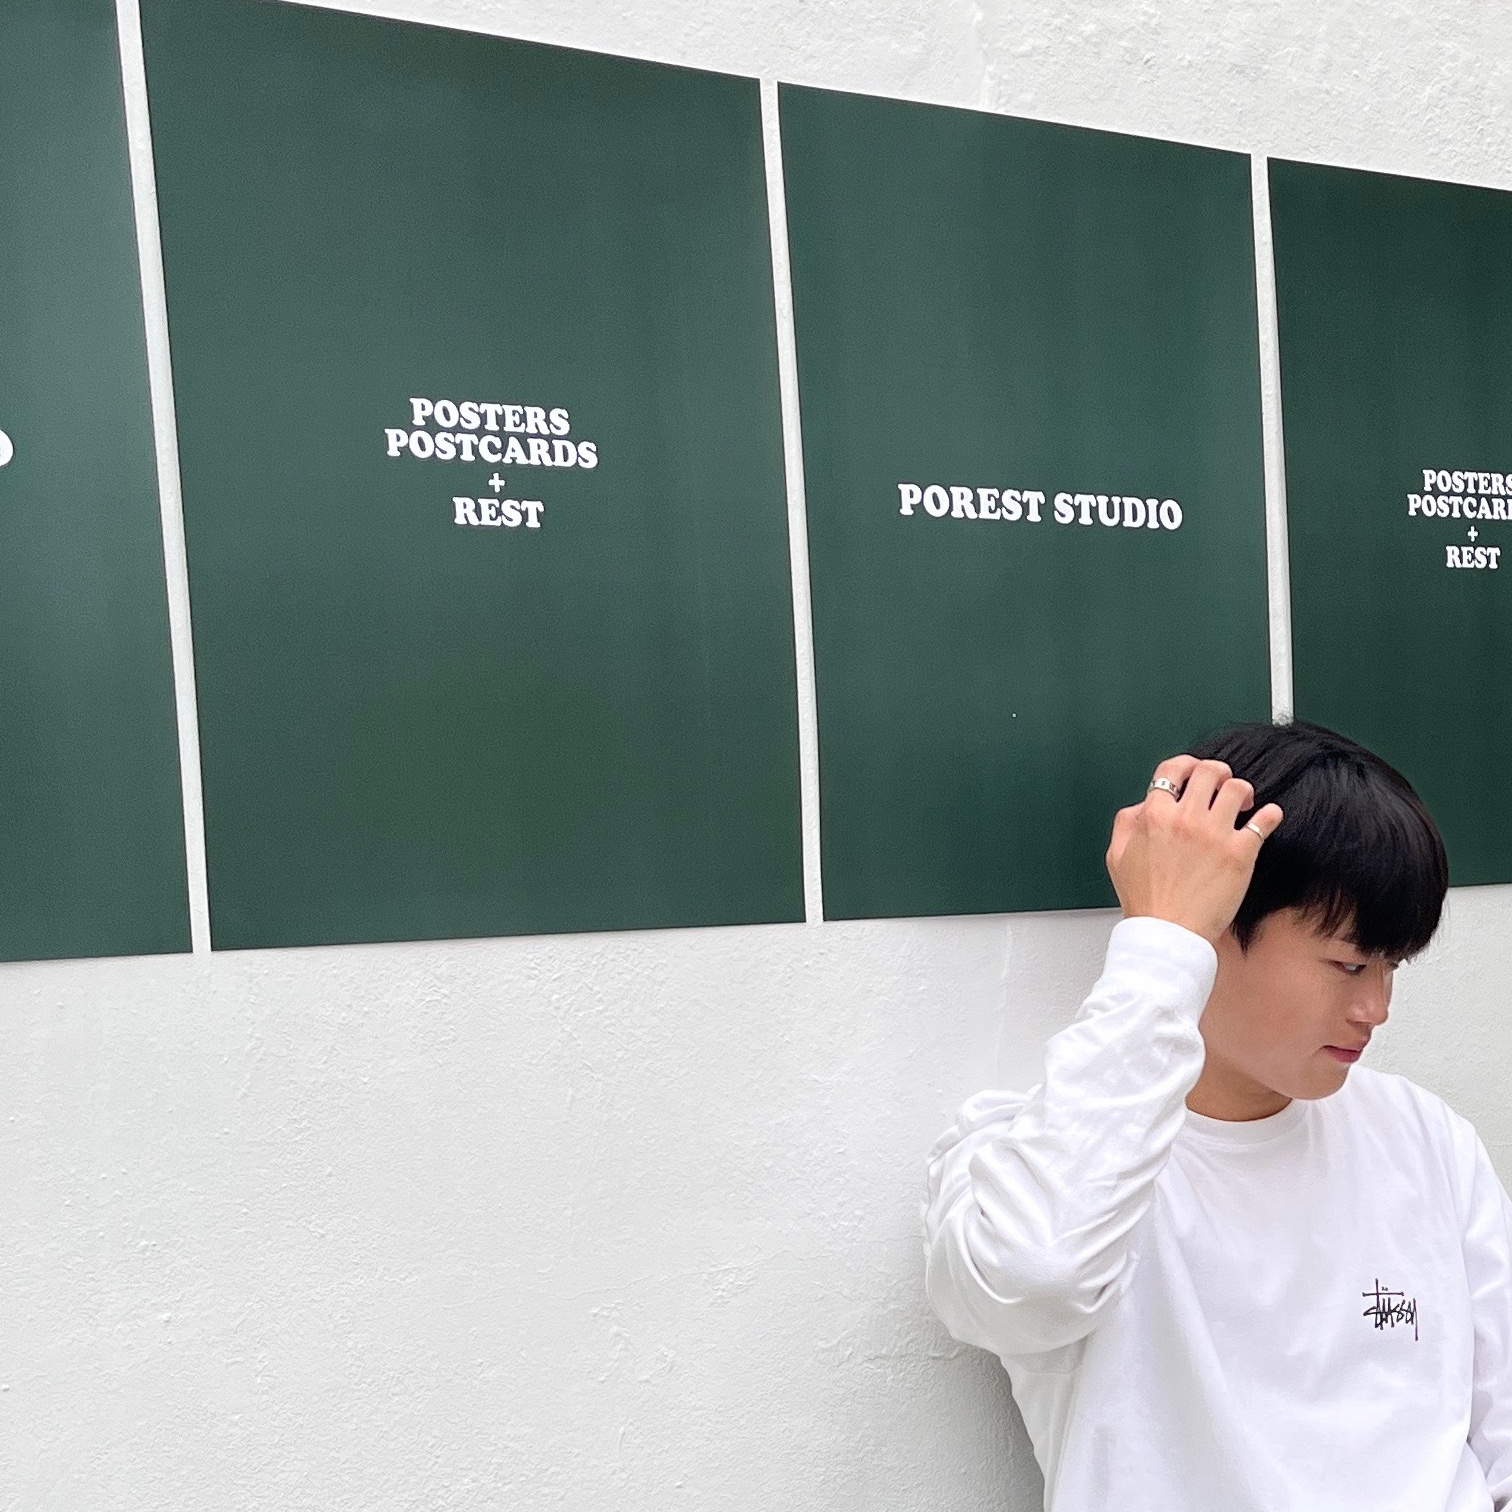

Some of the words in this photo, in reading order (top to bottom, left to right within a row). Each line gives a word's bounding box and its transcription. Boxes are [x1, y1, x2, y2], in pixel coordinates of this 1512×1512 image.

[410, 398, 570, 435] POSTERS
[384, 429, 598, 468] POSTCARDS
[453, 497, 544, 528] REST
[898, 484, 1045, 522] POREST
[1054, 493, 1182, 530] STUDIO
[1446, 546, 1500, 569] REST
